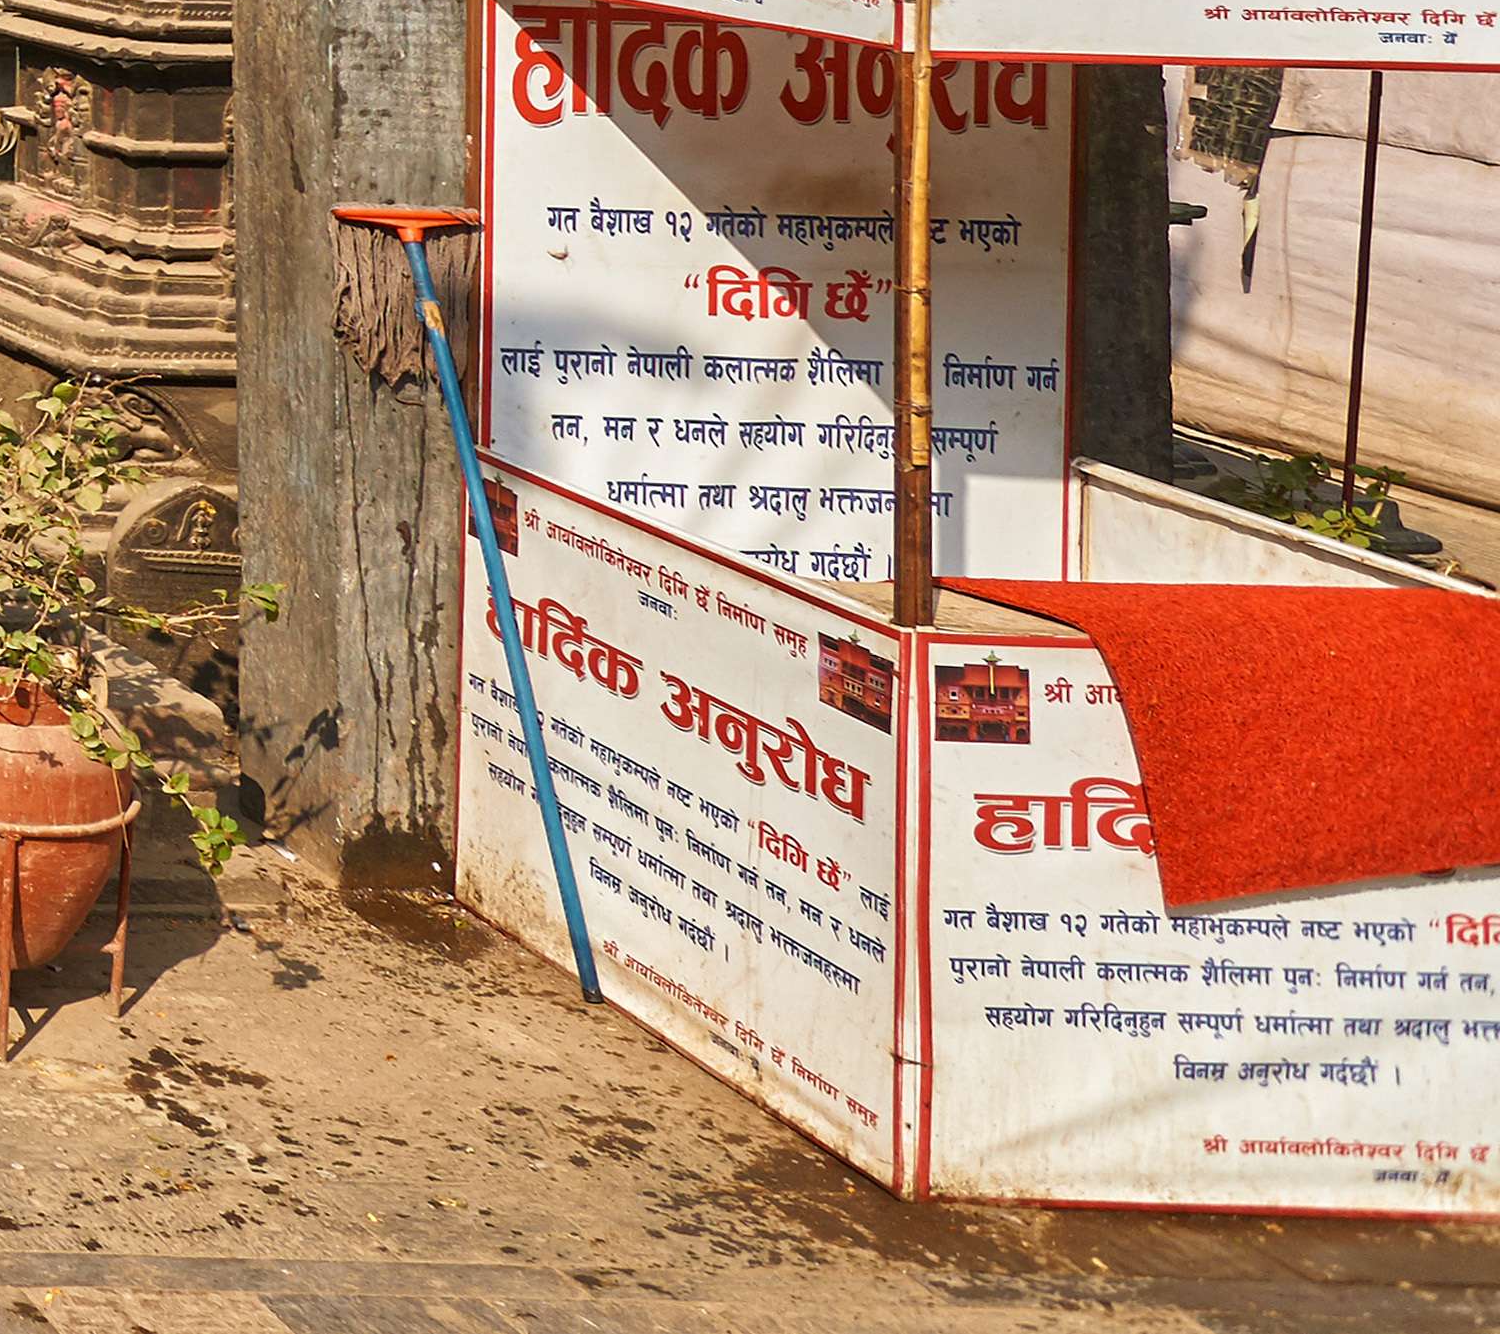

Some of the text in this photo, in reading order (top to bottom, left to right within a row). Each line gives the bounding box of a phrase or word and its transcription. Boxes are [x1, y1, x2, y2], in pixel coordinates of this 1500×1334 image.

[1204, 6, 1231, 19] श्री
[1421, 9, 1466, 26] दिगि
[547, 207, 580, 233] गत
[590, 197, 654, 236] बैशाख
[666, 211, 692, 242] १२
[705, 204, 767, 240] गतेको
[958, 214, 1022, 252] भएको
[500, 341, 1060, 392] लाई पुरानो नेपाली कलात्मक शैलिमा निर्माण गर्न
[603, 417, 637, 441] मन
[647, 418, 663, 447] र
[673, 413, 729, 448] धनले
[739, 414, 806, 451] सहयोग
[607, 473, 737, 510] धर्मात्मा तथा
[525, 509, 540, 531] श्री
[716, 591, 766, 634] निर्माण
[1045, 677, 1073, 703] श्री
[660, 670, 872, 823] अनुरोध
[699, 797, 740, 833] भएको
[859, 886, 891, 921] लाई
[685, 829, 732, 873] निर्माण
[799, 898, 823, 926] मन
[829, 916, 842, 941] र
[848, 927, 886, 963] धनले
[943, 910, 976, 929] गत
[986, 903, 1049, 932] बैशाख
[1060, 914, 1087, 937] १२
[1100, 910, 1160, 934] गतेको
[1301, 921, 1342, 940] नष्ट
[1353, 919, 1416, 946] भएको
[949, 954, 1011, 984] पुरानो
[1020, 955, 1086, 981] नेपाली
[1095, 962, 1190, 983] कलात्मक
[1200, 957, 1273, 986] शैलिमा
[1335, 962, 1406, 989] निर्माण
[1417, 966, 1448, 990] गर्न
[985, 1002, 1383, 1039] सहयोग गरिदिनुहुन सम्पूर्ण धर्मात्मा तथा
[1173, 1054, 1310, 1087] विनम्र अनुरोध
[1204, 1135, 1228, 1153] श्री
